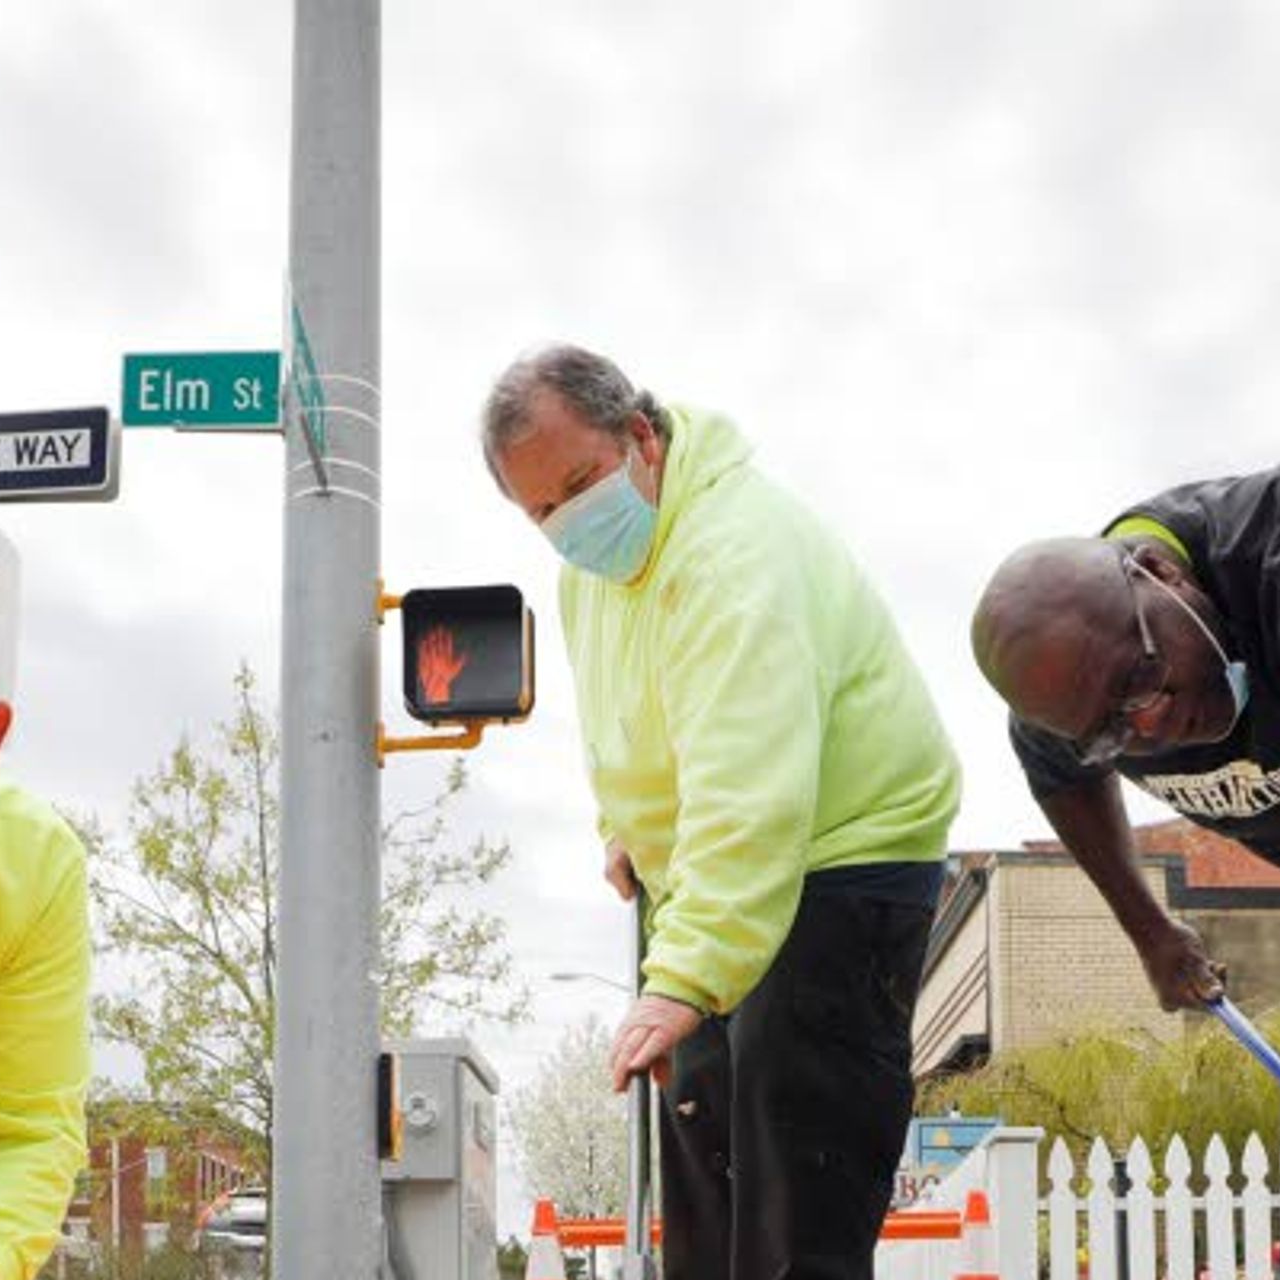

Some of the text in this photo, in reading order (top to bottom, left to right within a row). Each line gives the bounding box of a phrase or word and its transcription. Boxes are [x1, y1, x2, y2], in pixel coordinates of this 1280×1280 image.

[139, 368, 262, 411] Elm St
[13, 433, 82, 465] WAY
